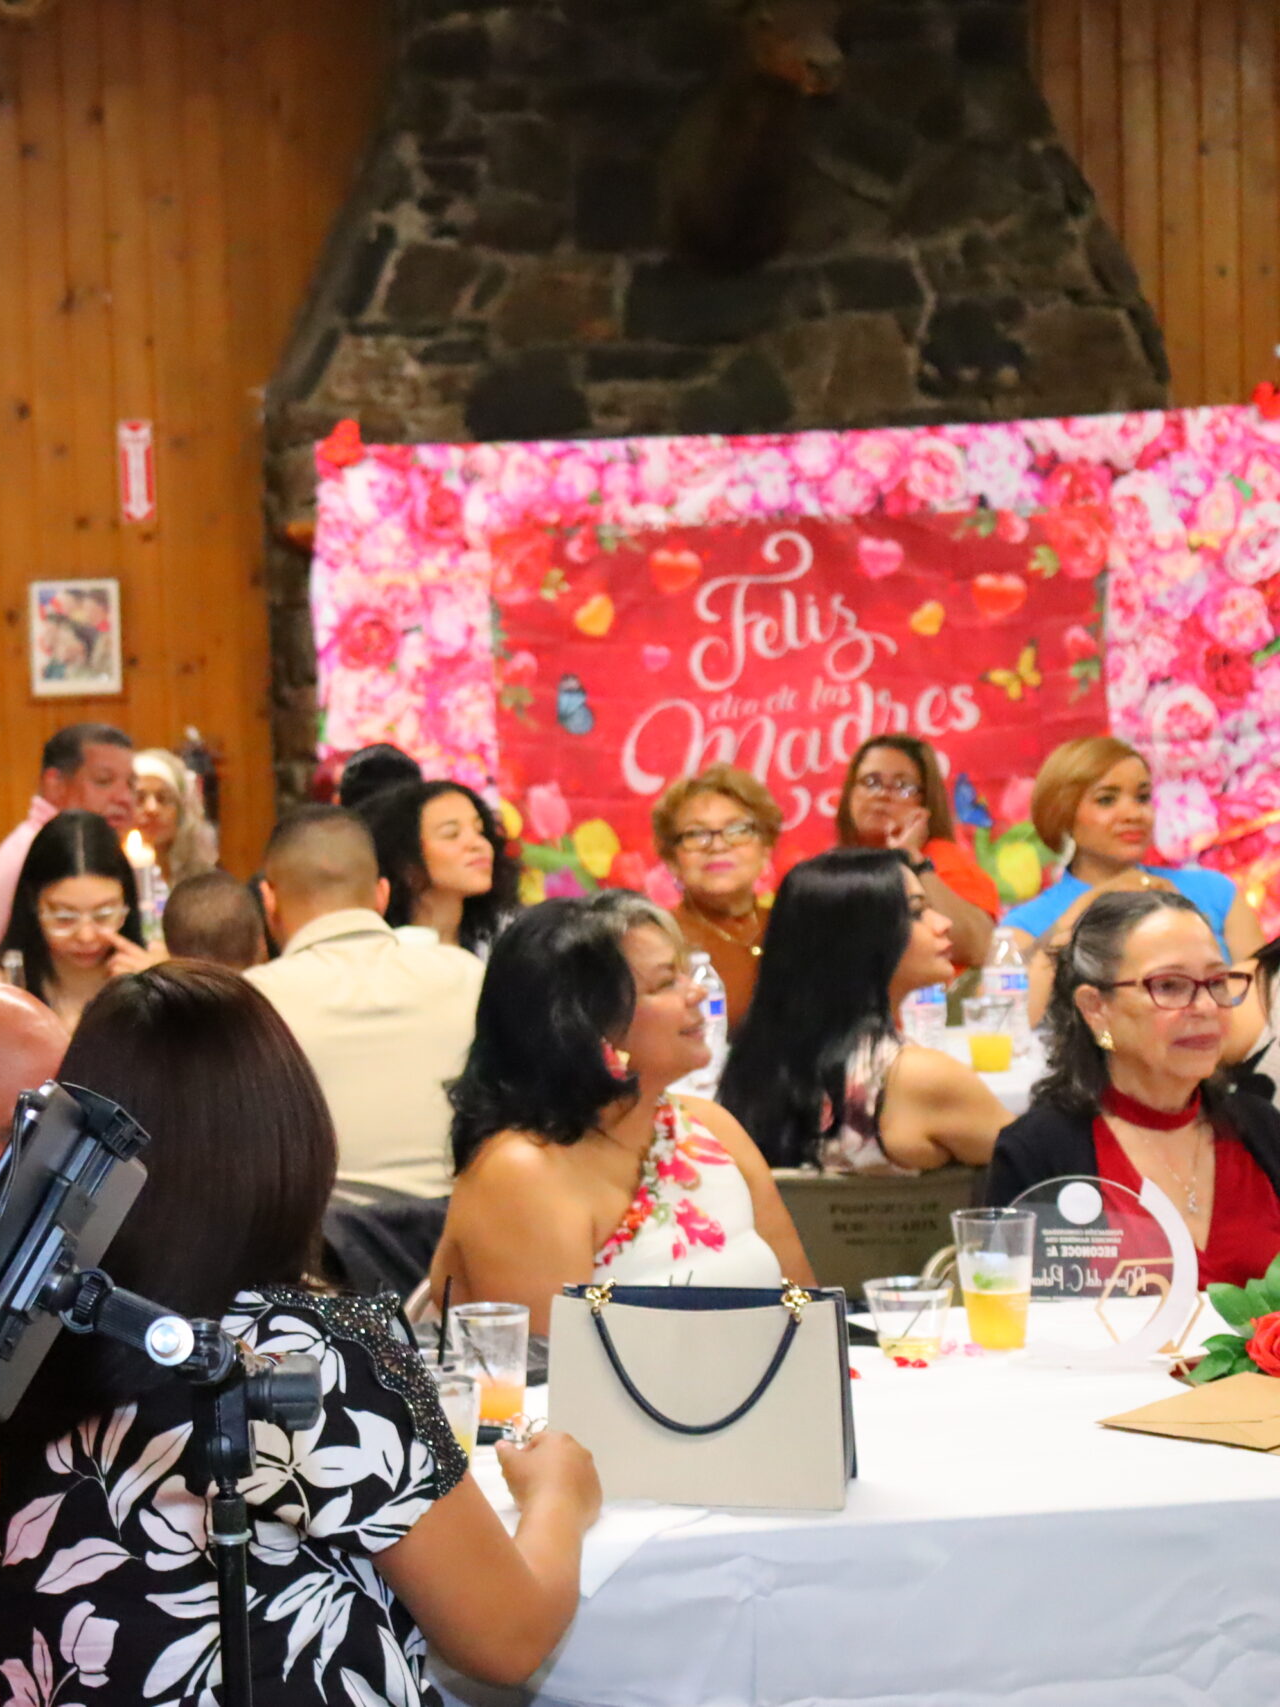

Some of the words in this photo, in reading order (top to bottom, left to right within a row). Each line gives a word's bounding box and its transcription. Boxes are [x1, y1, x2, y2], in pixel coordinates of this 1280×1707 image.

[689, 530, 898, 692] Feliz
[622, 681, 981, 795] Madres
[765, 685, 799, 712] de
[809, 676, 852, 711] las
